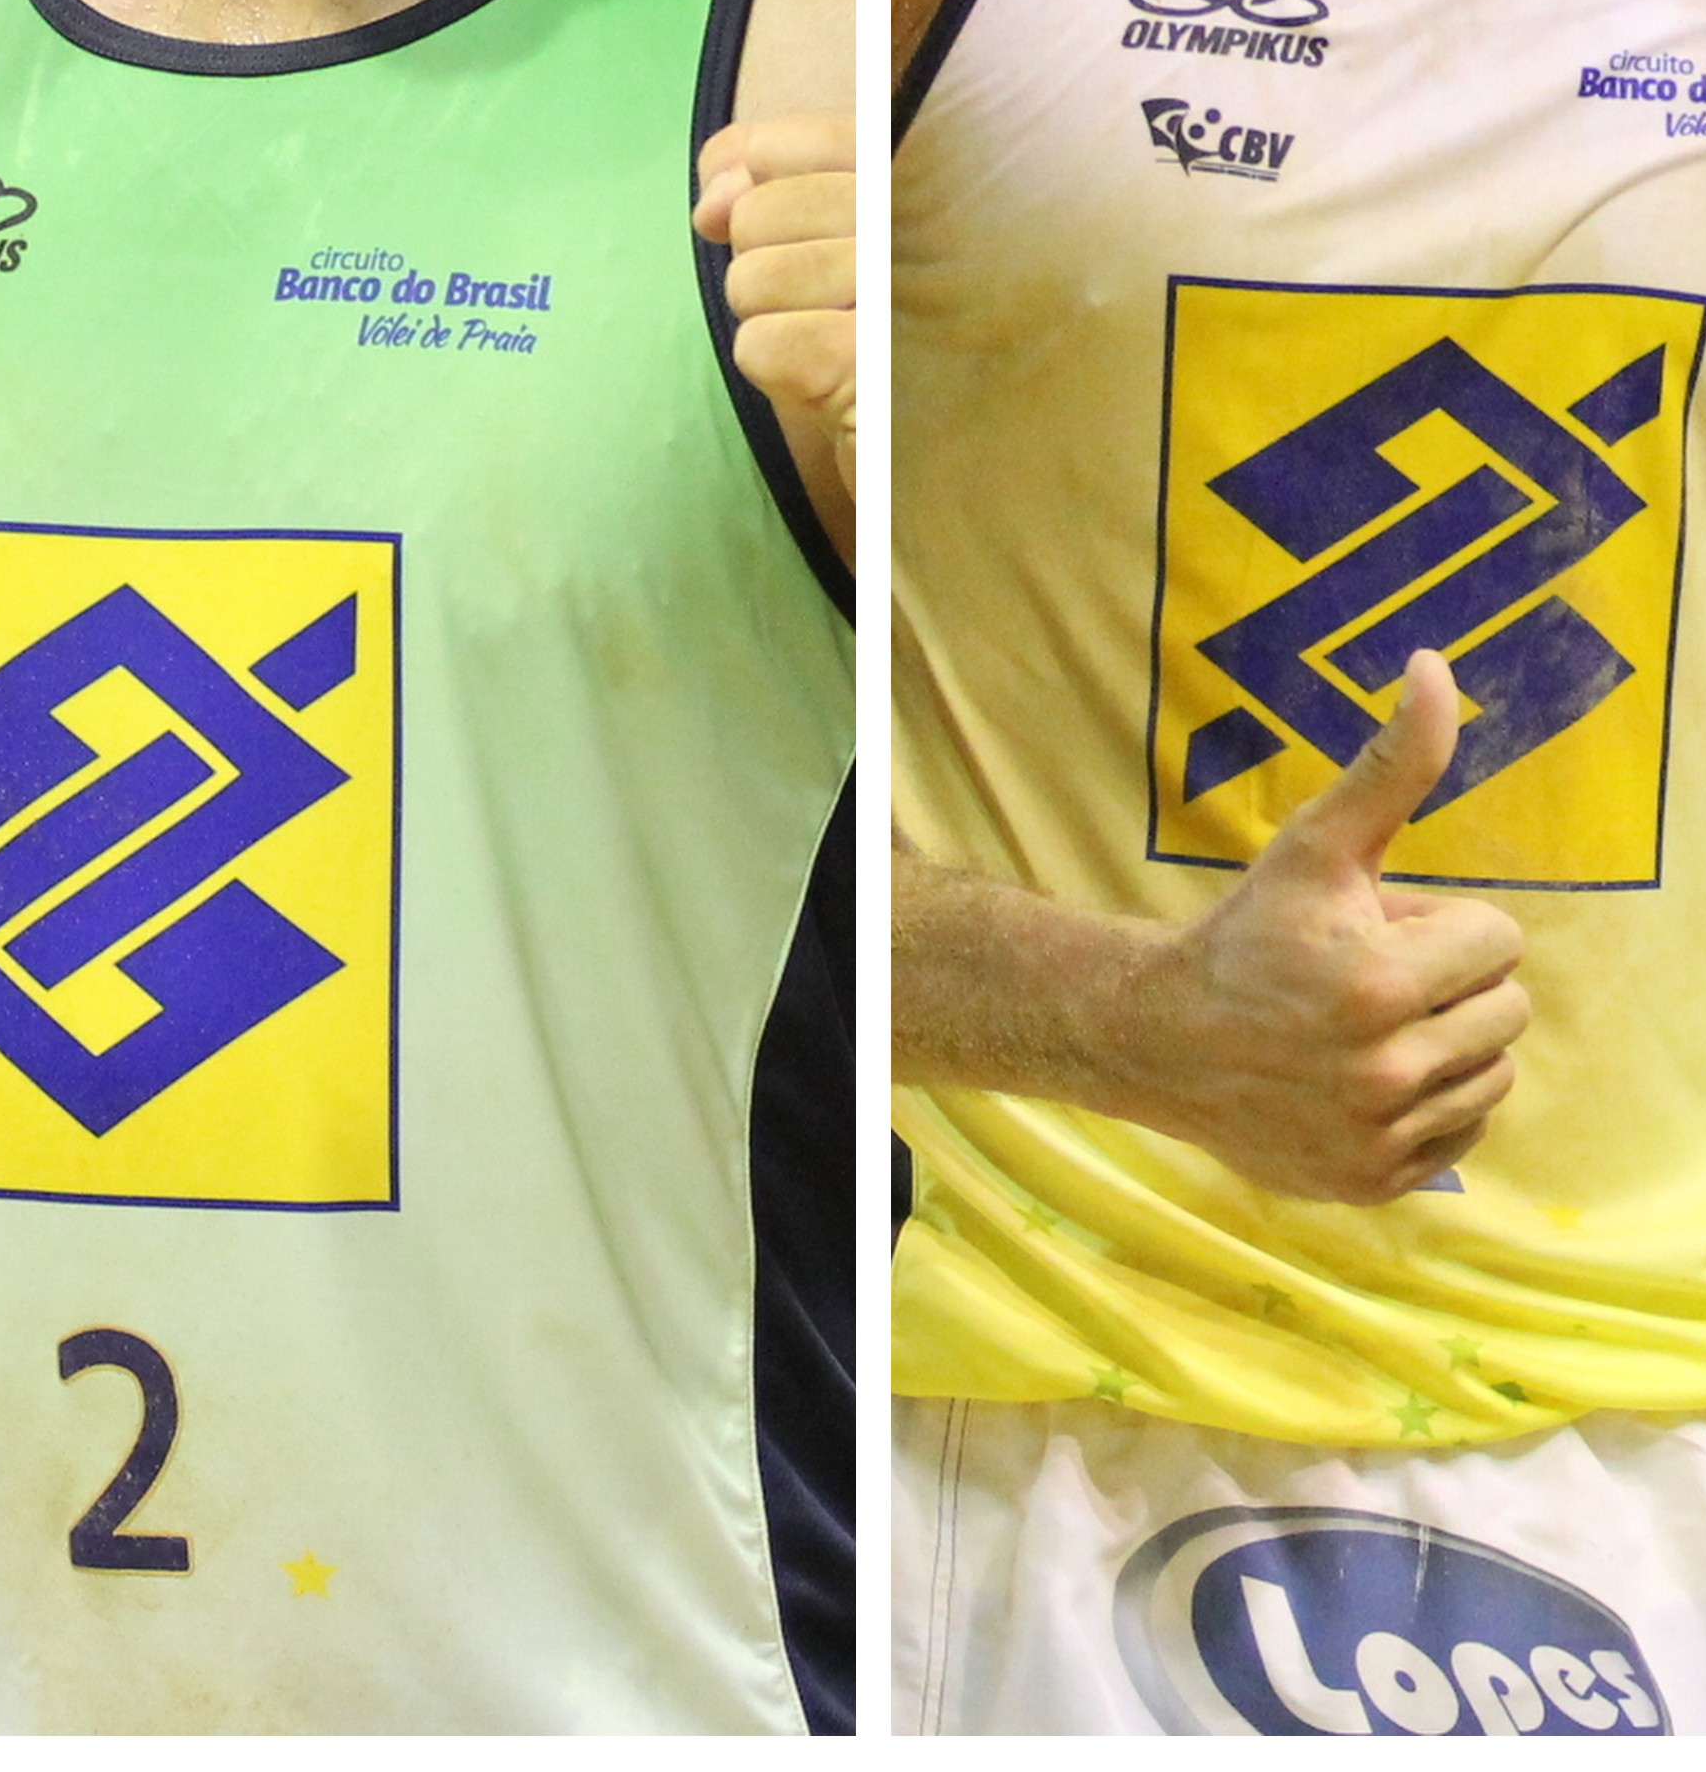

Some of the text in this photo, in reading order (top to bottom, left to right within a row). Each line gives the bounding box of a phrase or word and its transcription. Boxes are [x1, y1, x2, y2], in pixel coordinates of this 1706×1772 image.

[1121, 19, 1329, 67] OLYMPIKUS
[1609, 50, 1694, 76] circuito
[1578, 67, 1677, 101] Banco
[1219, 126, 1295, 169] CBV
[310, 246, 404, 272] circuito
[274, 268, 551, 310] Banco do Brasil
[357, 313, 537, 354] Vôlei de Praia
[57, 1328, 189, 1572] 2
[1241, 1574, 1659, 1736] Lopes
